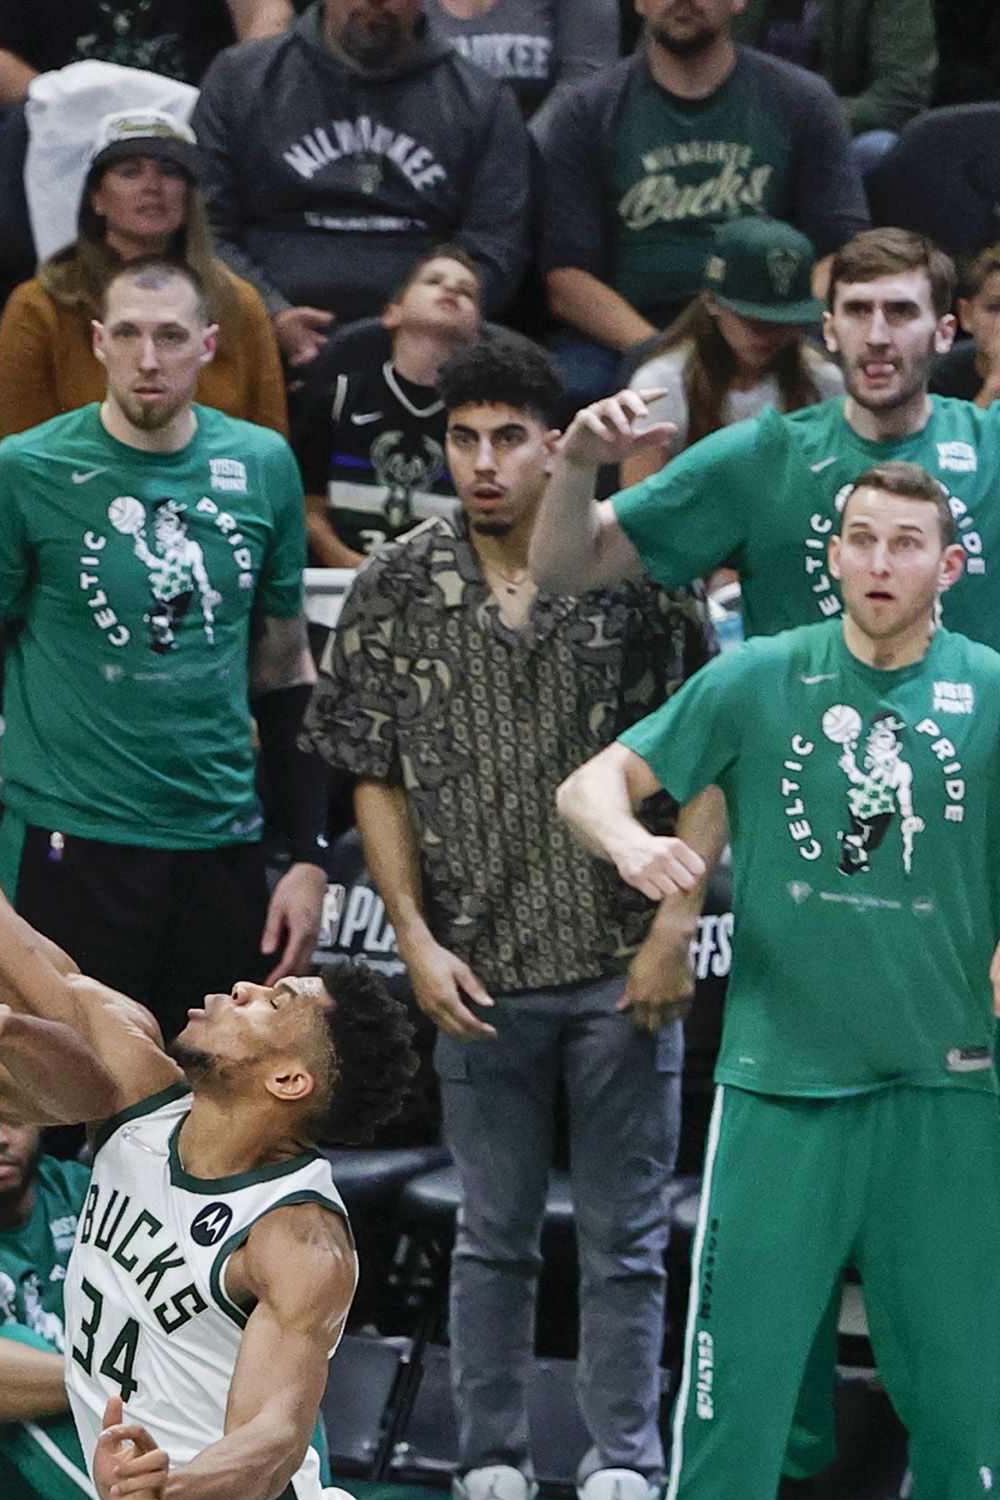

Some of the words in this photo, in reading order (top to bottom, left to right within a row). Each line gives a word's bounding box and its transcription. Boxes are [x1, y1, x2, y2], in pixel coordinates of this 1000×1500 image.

[80, 531, 130, 647] CELTIC
[196, 496, 253, 588] PRIDE
[805, 513, 845, 618] ELTIC
[941, 482, 985, 574] RIDE
[782, 734, 821, 860] CELTIC
[915, 718, 965, 822] PRIDE
[80, 1184, 208, 1335] BUCKS
[72, 1276, 140, 1404] 34
[696, 1330, 714, 1420] CELTICS
